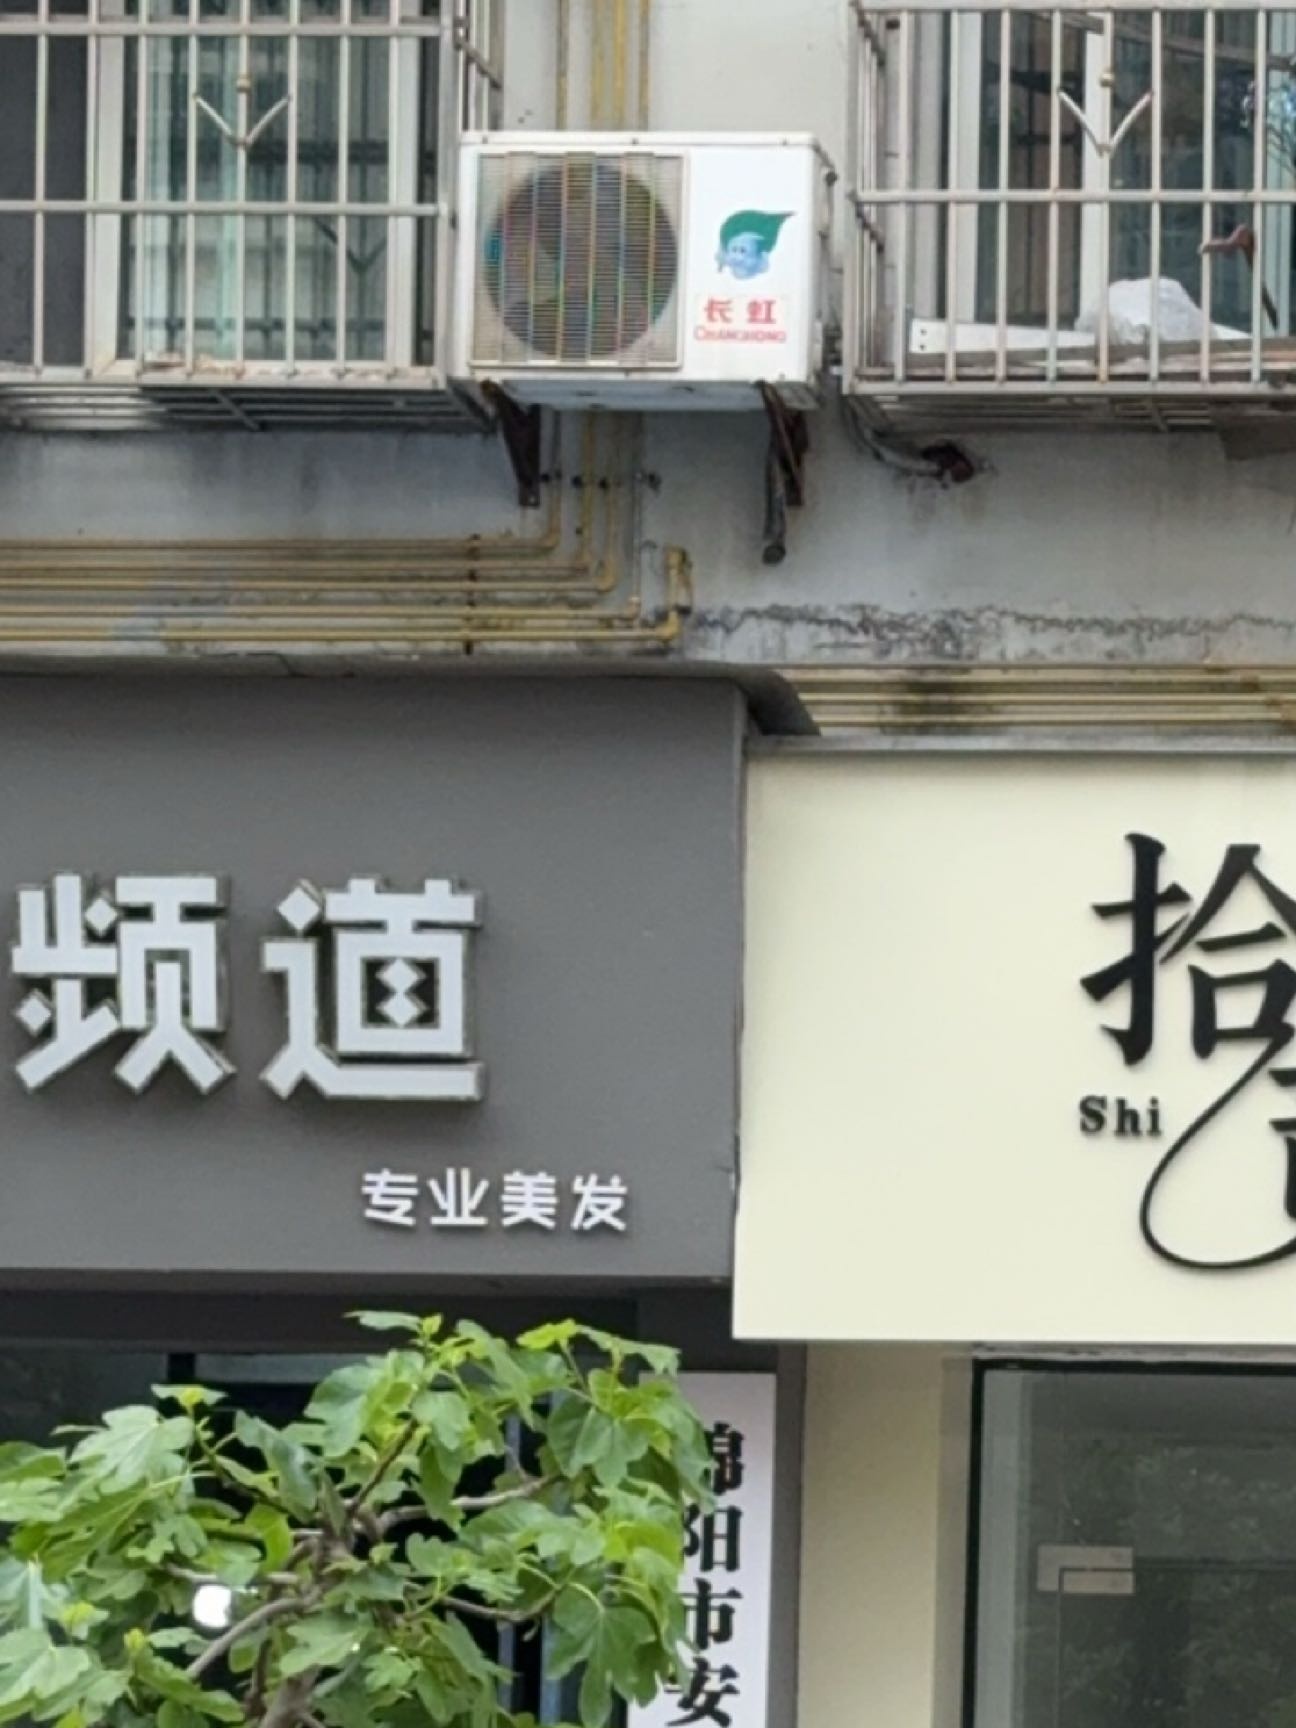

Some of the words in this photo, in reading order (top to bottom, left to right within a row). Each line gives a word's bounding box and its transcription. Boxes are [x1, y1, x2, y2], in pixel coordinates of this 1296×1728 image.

[704, 296, 777, 324] 长虹
[12, 874, 484, 1100] 频道
[1080, 1095, 1162, 1136] Shi
[361, 1168, 629, 1231] 专业美发
